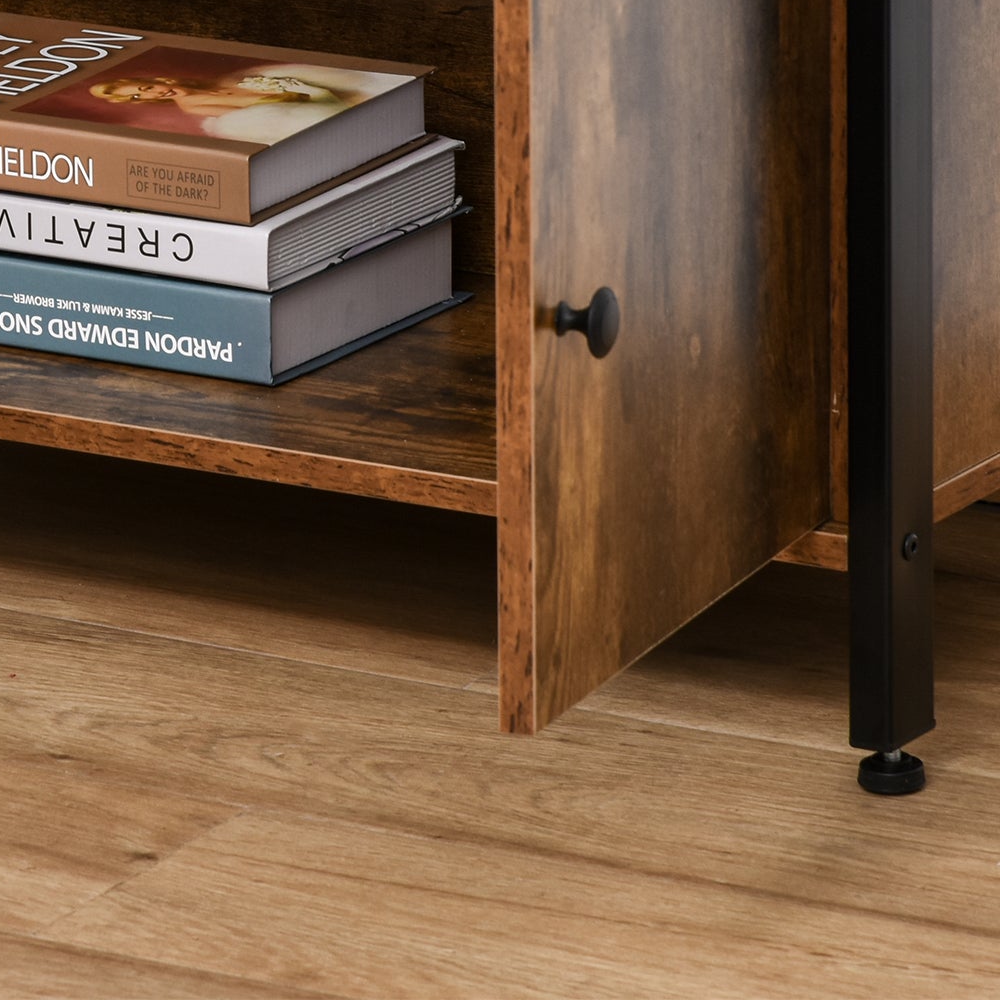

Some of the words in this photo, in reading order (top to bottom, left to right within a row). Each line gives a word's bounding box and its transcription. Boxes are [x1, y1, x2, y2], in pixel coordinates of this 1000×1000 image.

[129, 164, 149, 178] ARE
[152, 167, 174, 181] YOU
[177, 171, 215, 187] AFRAID
[136, 180, 150, 193] OF
[152, 182, 172, 197] THE
[175, 185, 209, 201] DARK?
[56, 298, 81, 312] LUKE
[82, 302, 90, 313] &
[91, 303, 124, 318] KAMM
[47, 318, 139, 350] EDWARD
